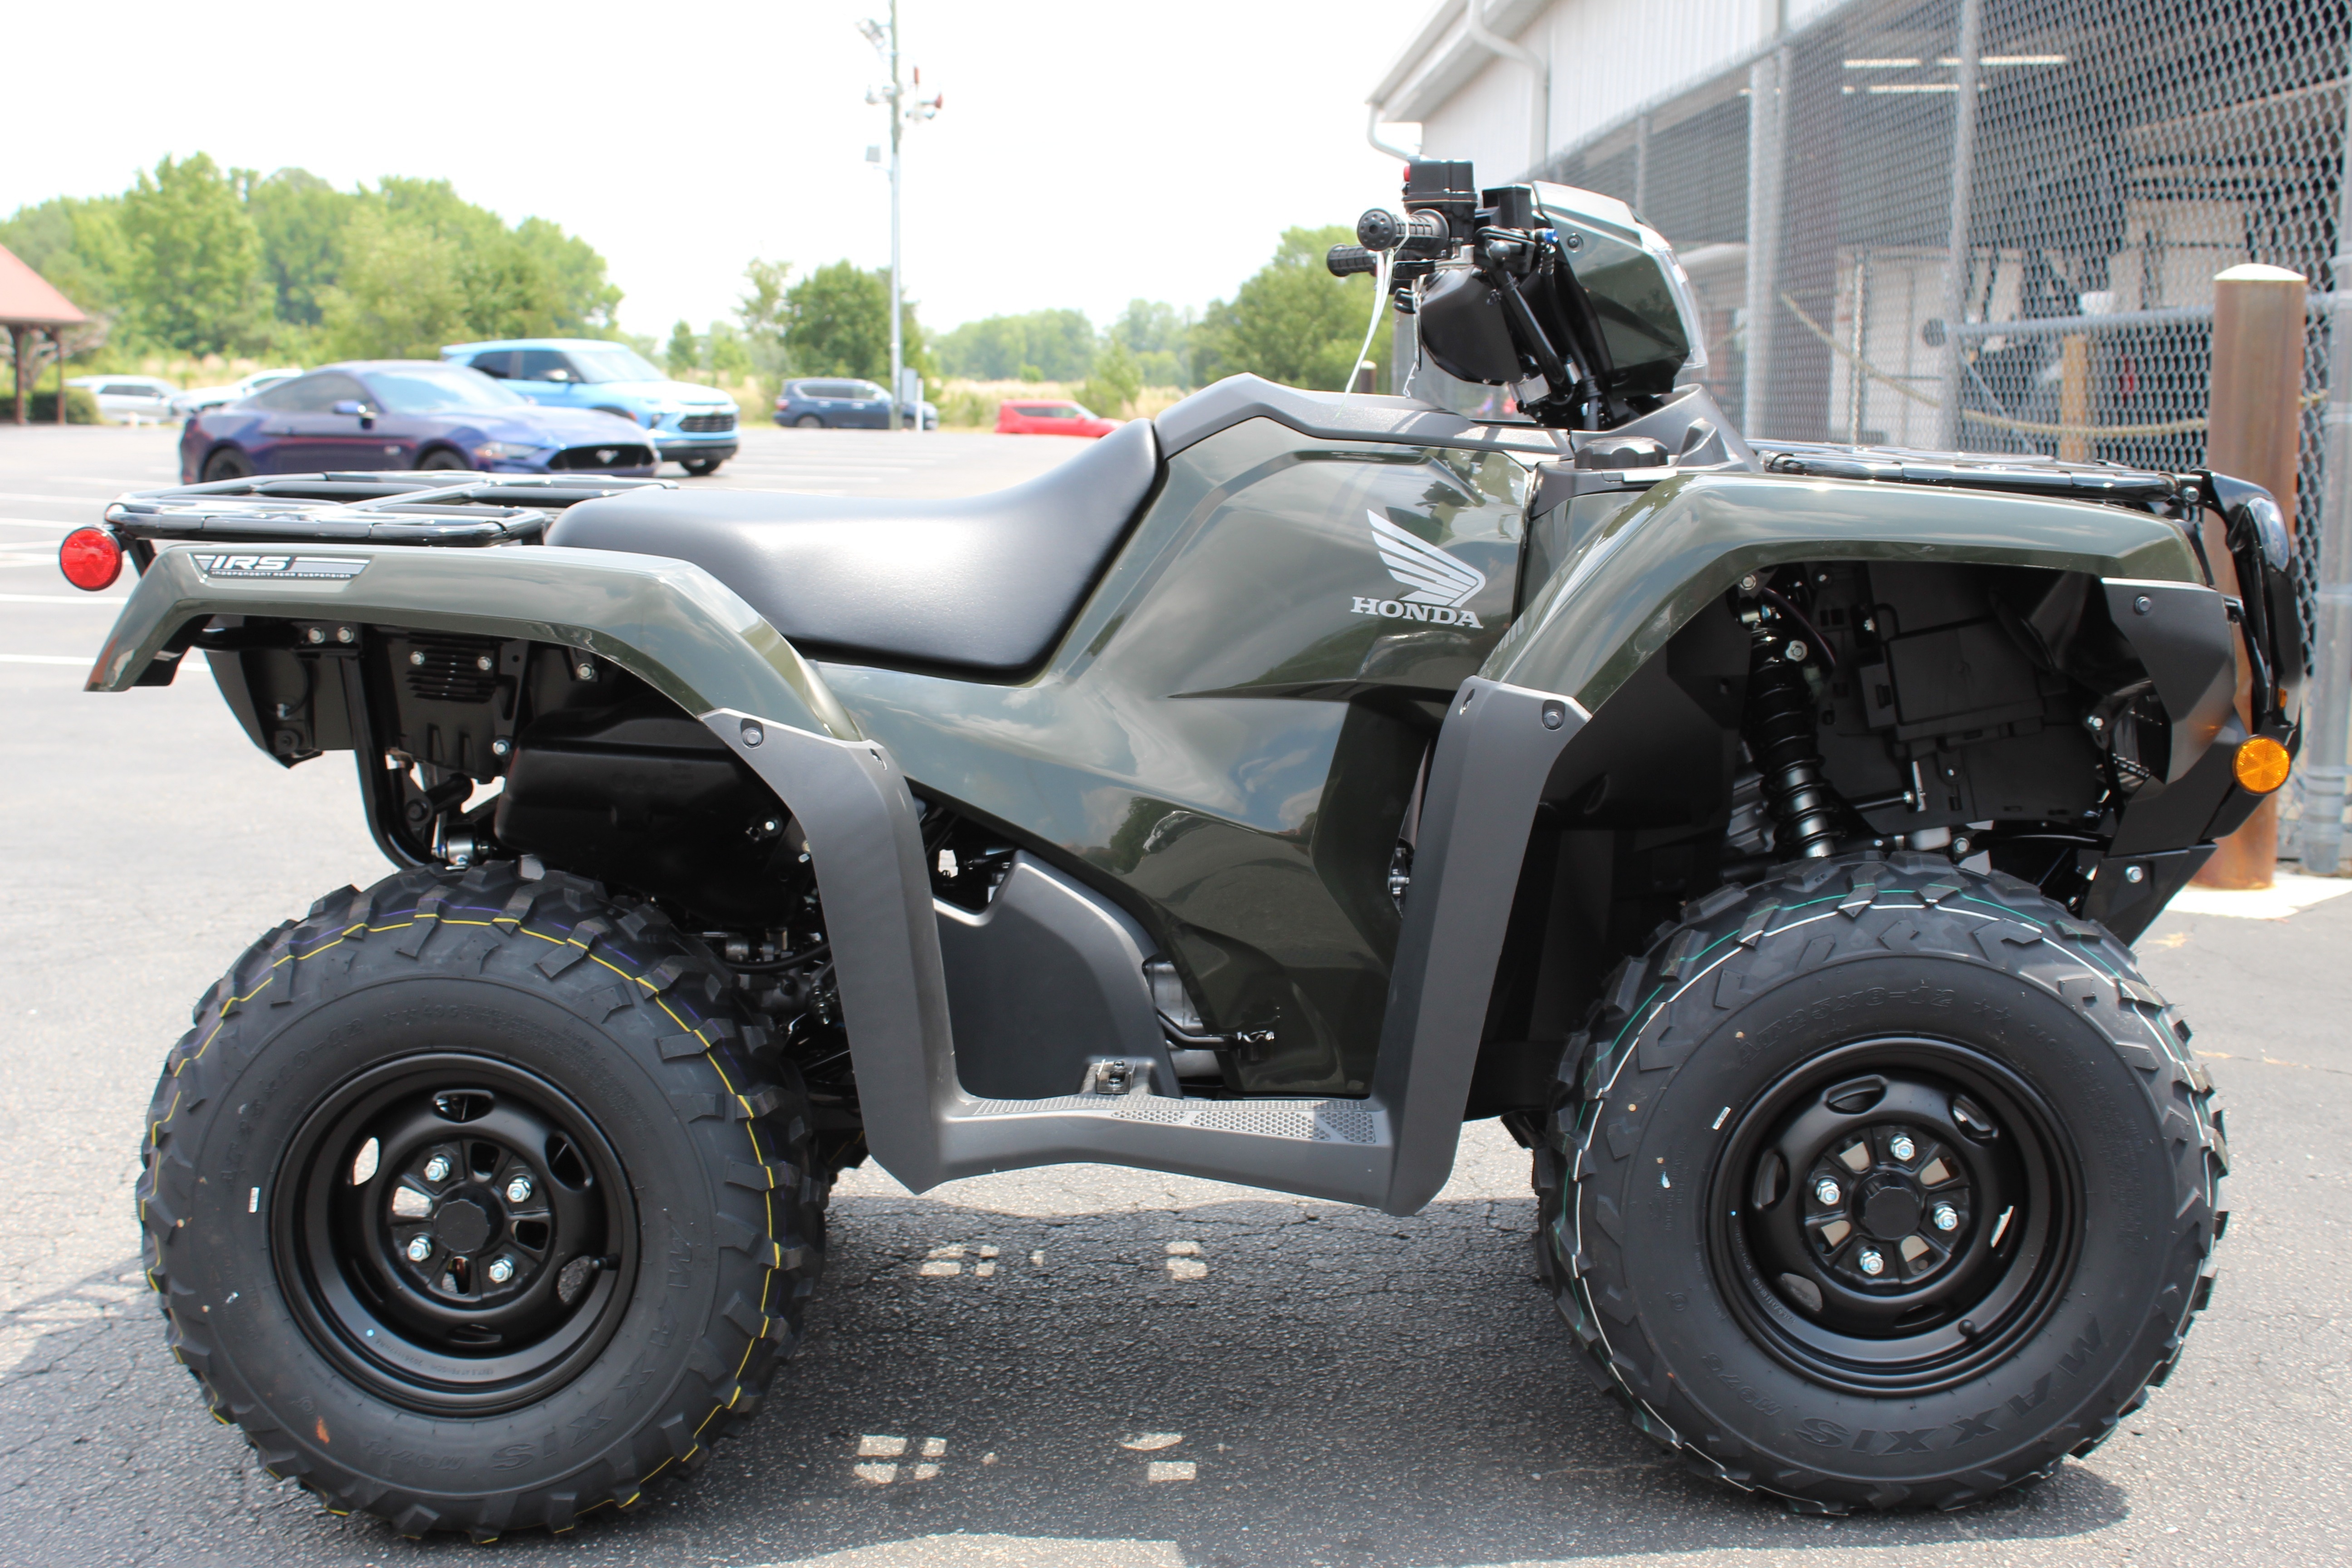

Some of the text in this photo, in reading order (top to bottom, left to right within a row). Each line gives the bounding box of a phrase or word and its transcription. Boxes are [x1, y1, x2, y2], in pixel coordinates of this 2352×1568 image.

[211, 555, 291, 570] IRS
[1351, 597, 1484, 629] HONDA
[490, 1225, 696, 1473] MAXXIS
[1702, 1351, 1784, 1419] M975
[1795, 1315, 2104, 1455] MAXXIS
